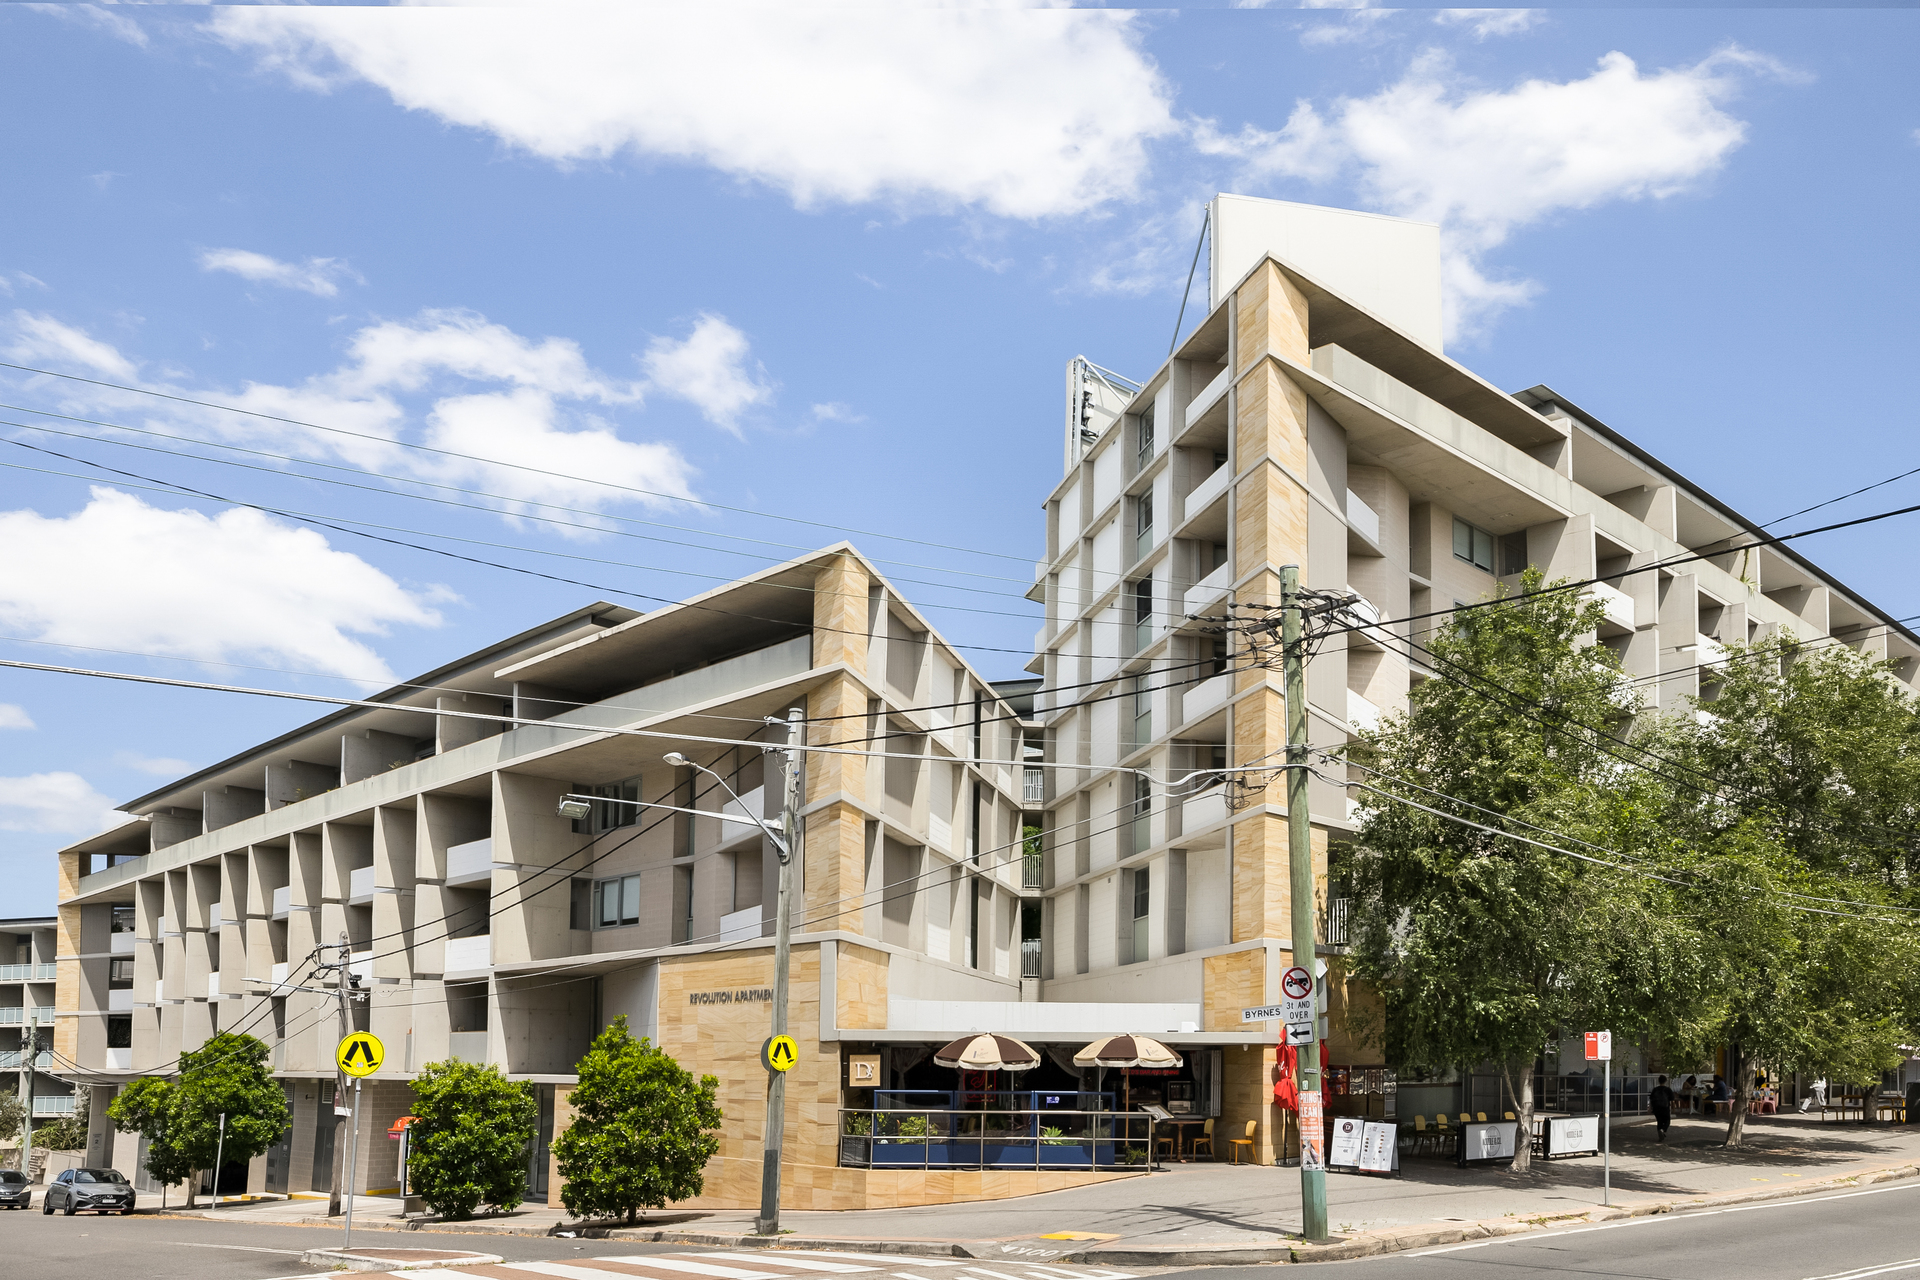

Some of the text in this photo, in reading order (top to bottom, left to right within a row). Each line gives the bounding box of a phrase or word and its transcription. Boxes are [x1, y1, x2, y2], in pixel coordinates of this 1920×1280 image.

[690, 989, 774, 1005] REVOLUTION APARTMEN
[1286, 1000, 1311, 1010] 3t AND
[1245, 1007, 1281, 1019] BYRNES
[1289, 1010, 1309, 1020] OVER
[1300, 1092, 1318, 1104] PRING
[1301, 1106, 1318, 1117] LEAN
